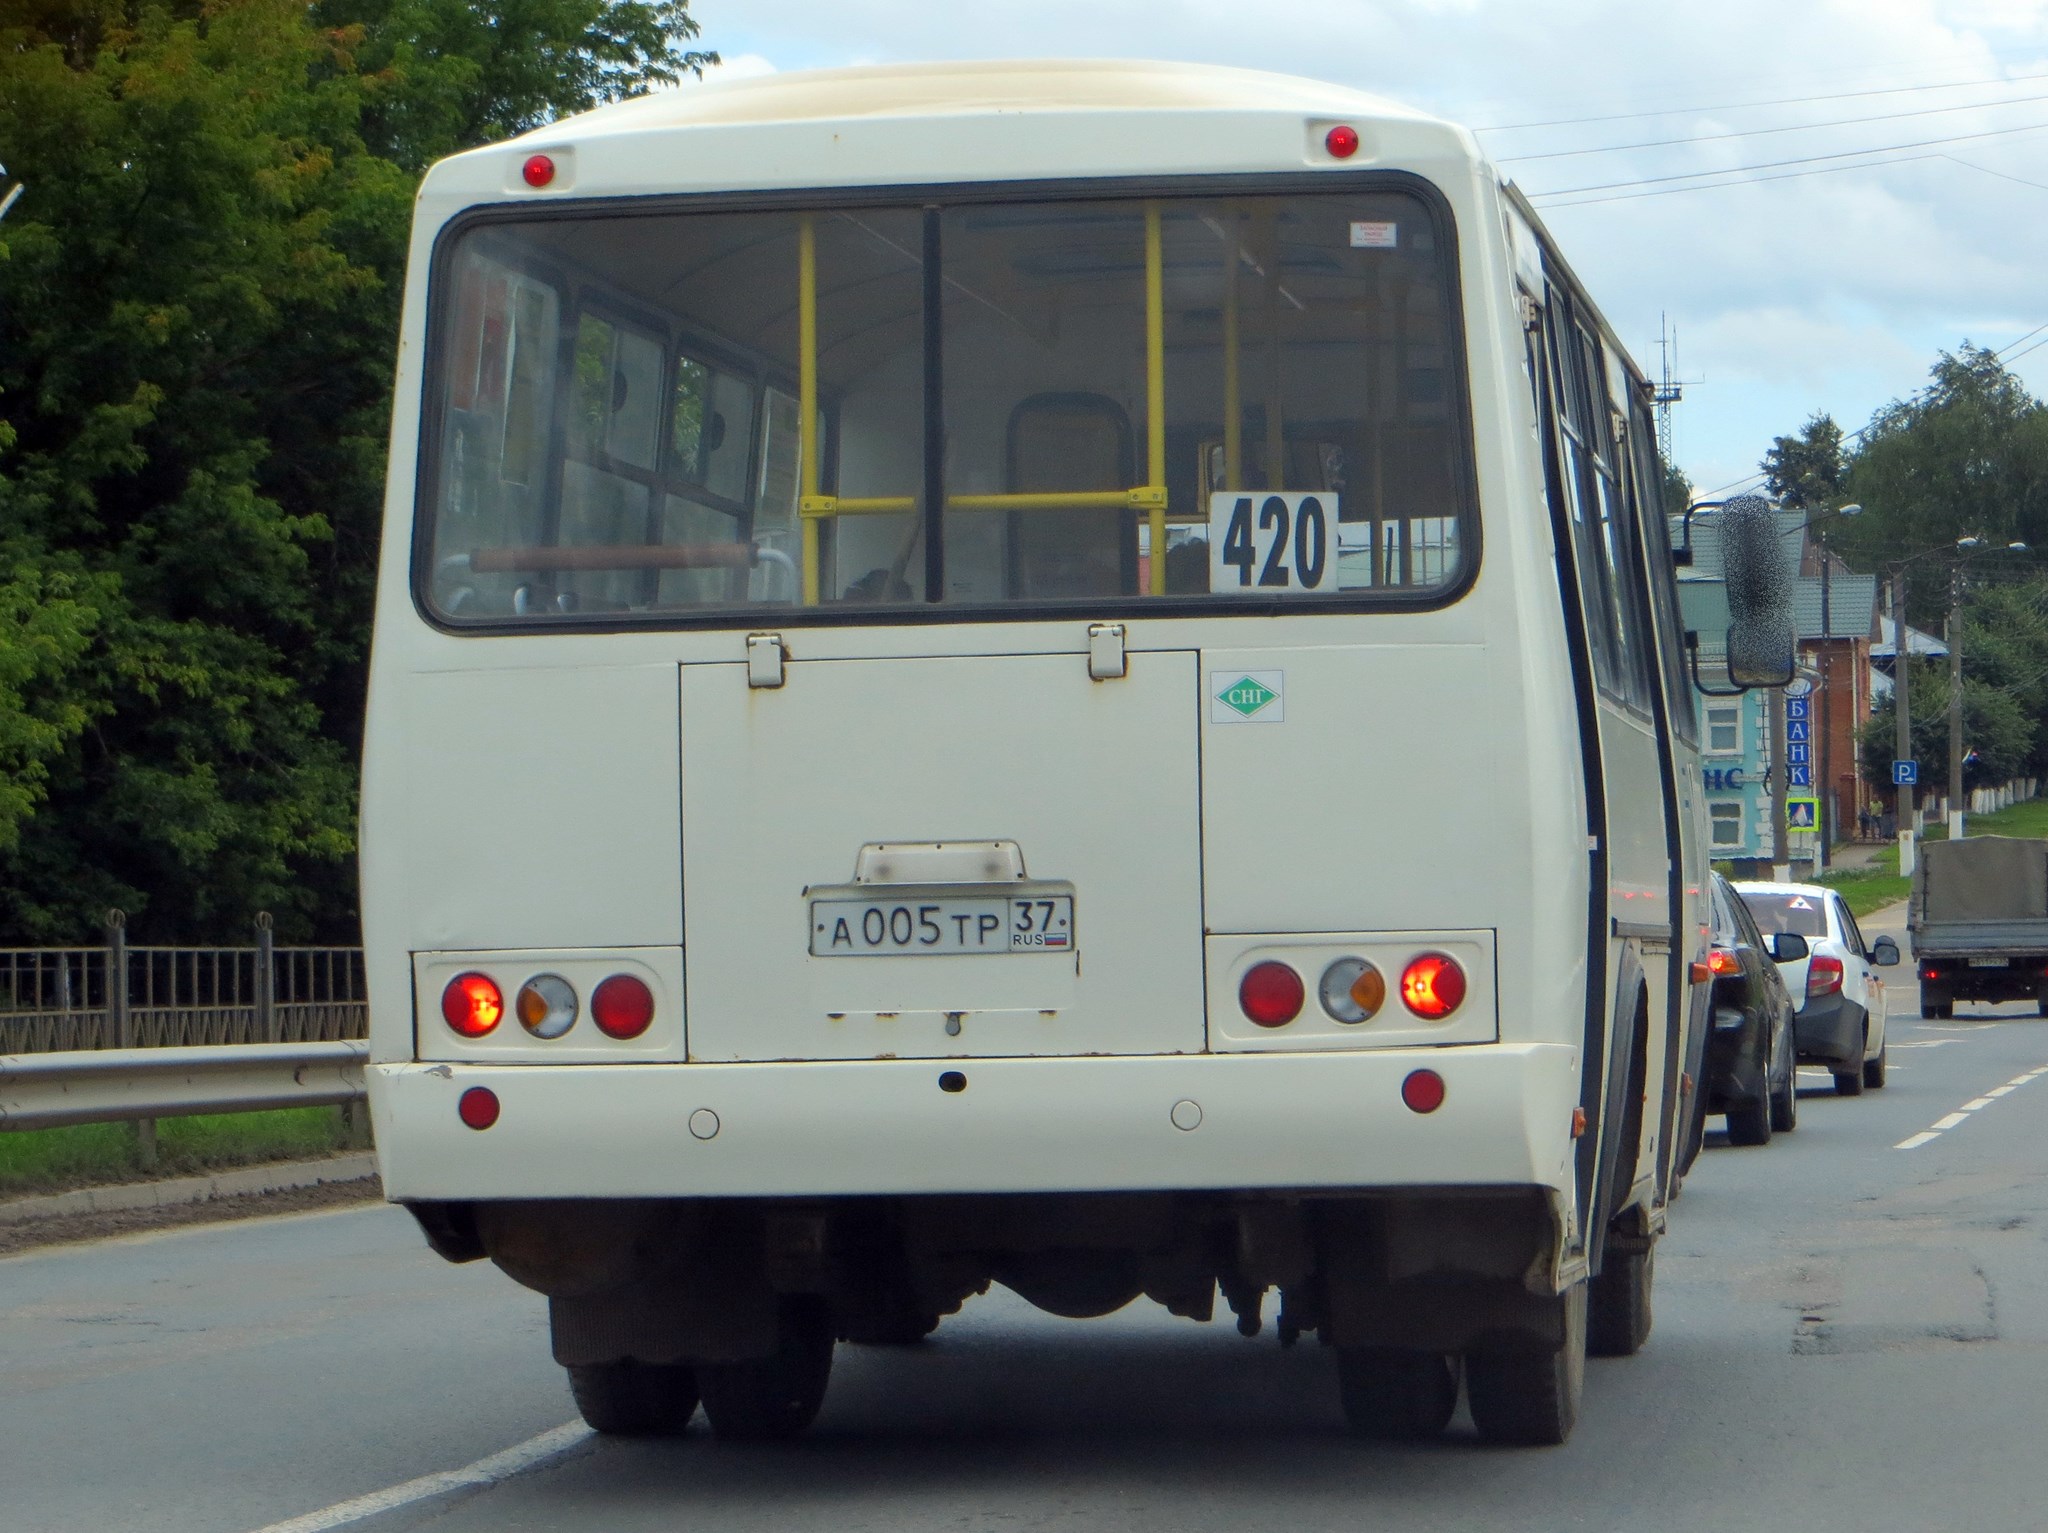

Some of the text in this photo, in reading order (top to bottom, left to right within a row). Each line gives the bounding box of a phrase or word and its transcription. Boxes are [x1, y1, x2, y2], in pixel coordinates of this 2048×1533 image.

[1223, 495, 1326, 589] 420
[1791, 700, 1805, 783] БАНК
[1898, 765, 1910, 782] P
[1015, 901, 1055, 932] 37
[1013, 934, 1044, 946] RUS
